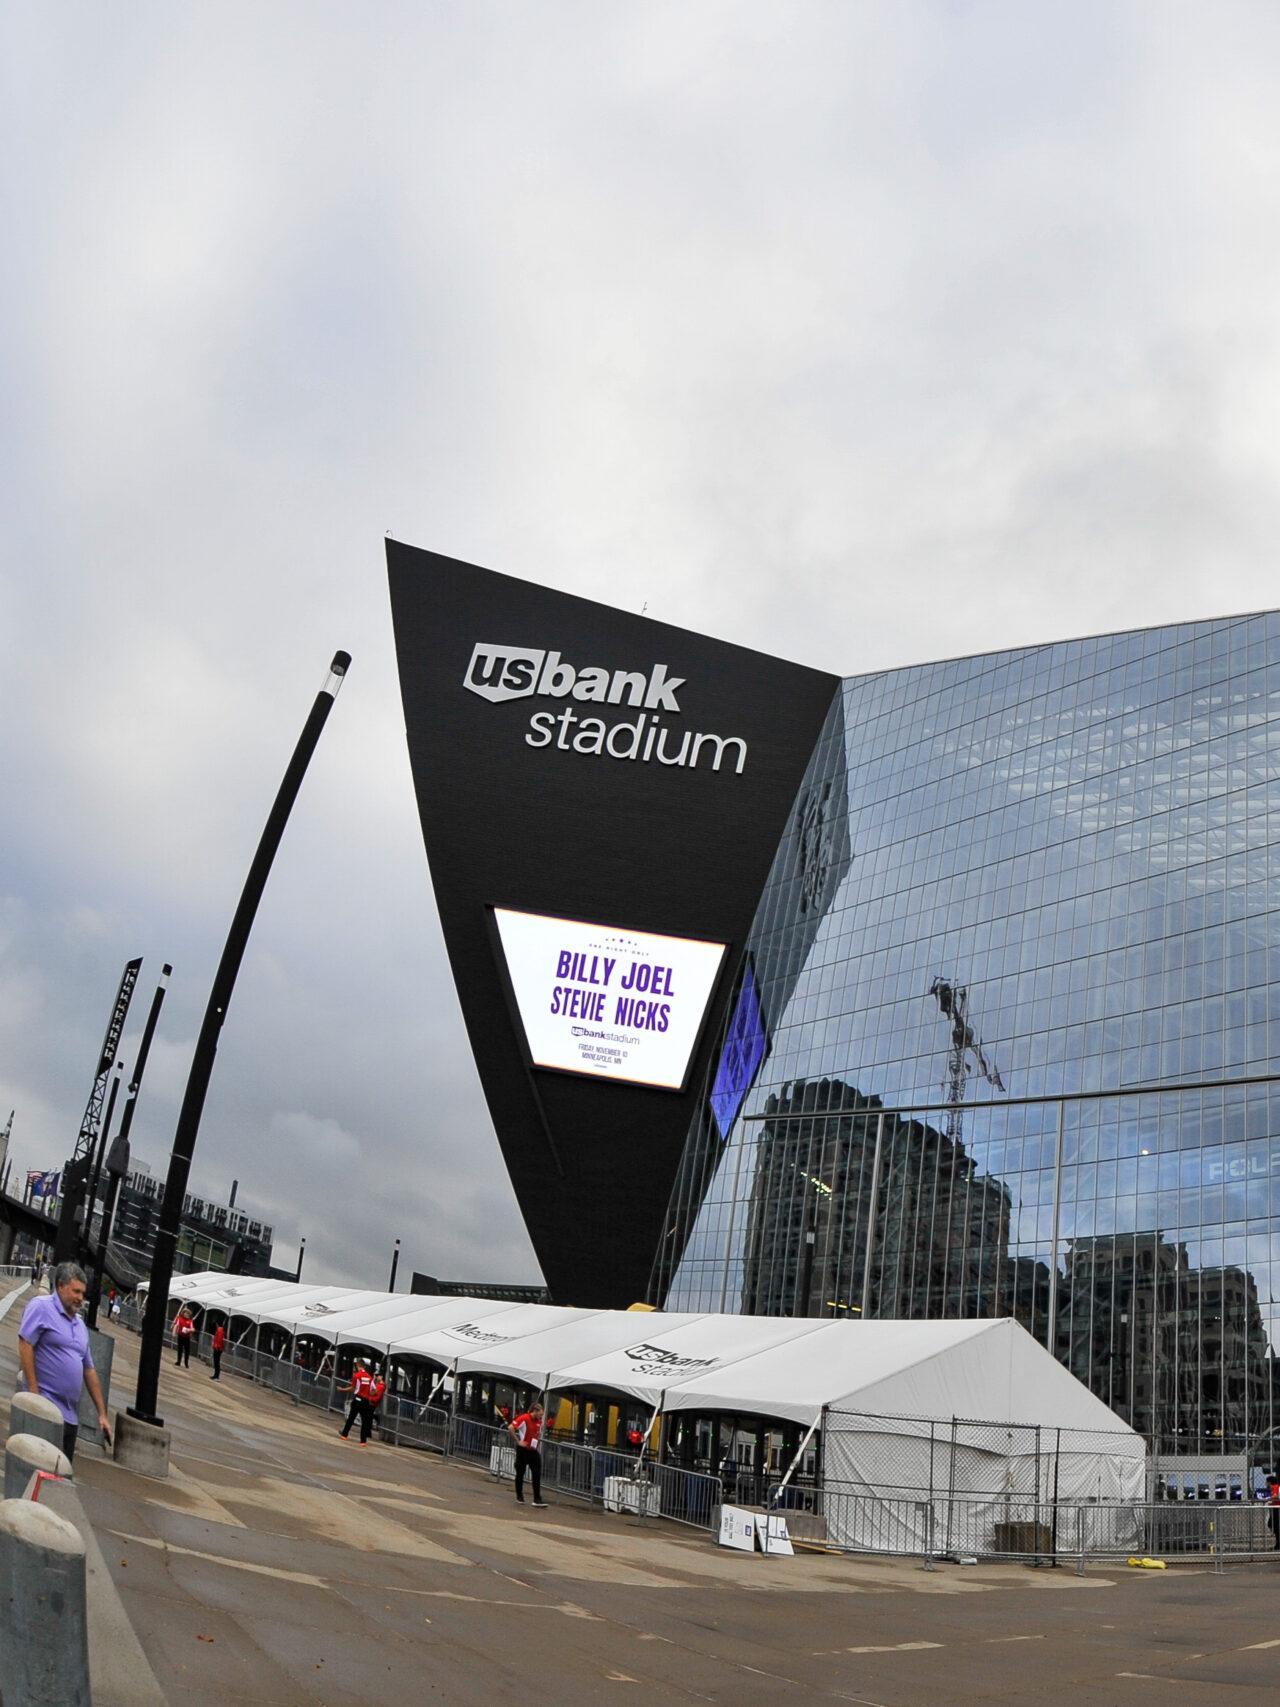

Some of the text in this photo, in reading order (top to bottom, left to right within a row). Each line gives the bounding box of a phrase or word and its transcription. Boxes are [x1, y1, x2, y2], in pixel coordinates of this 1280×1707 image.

[525, 707, 747, 774] stadium
[556, 950, 674, 997] BILLY JOEL
[550, 985, 671, 1032] STEVIE NICKS
